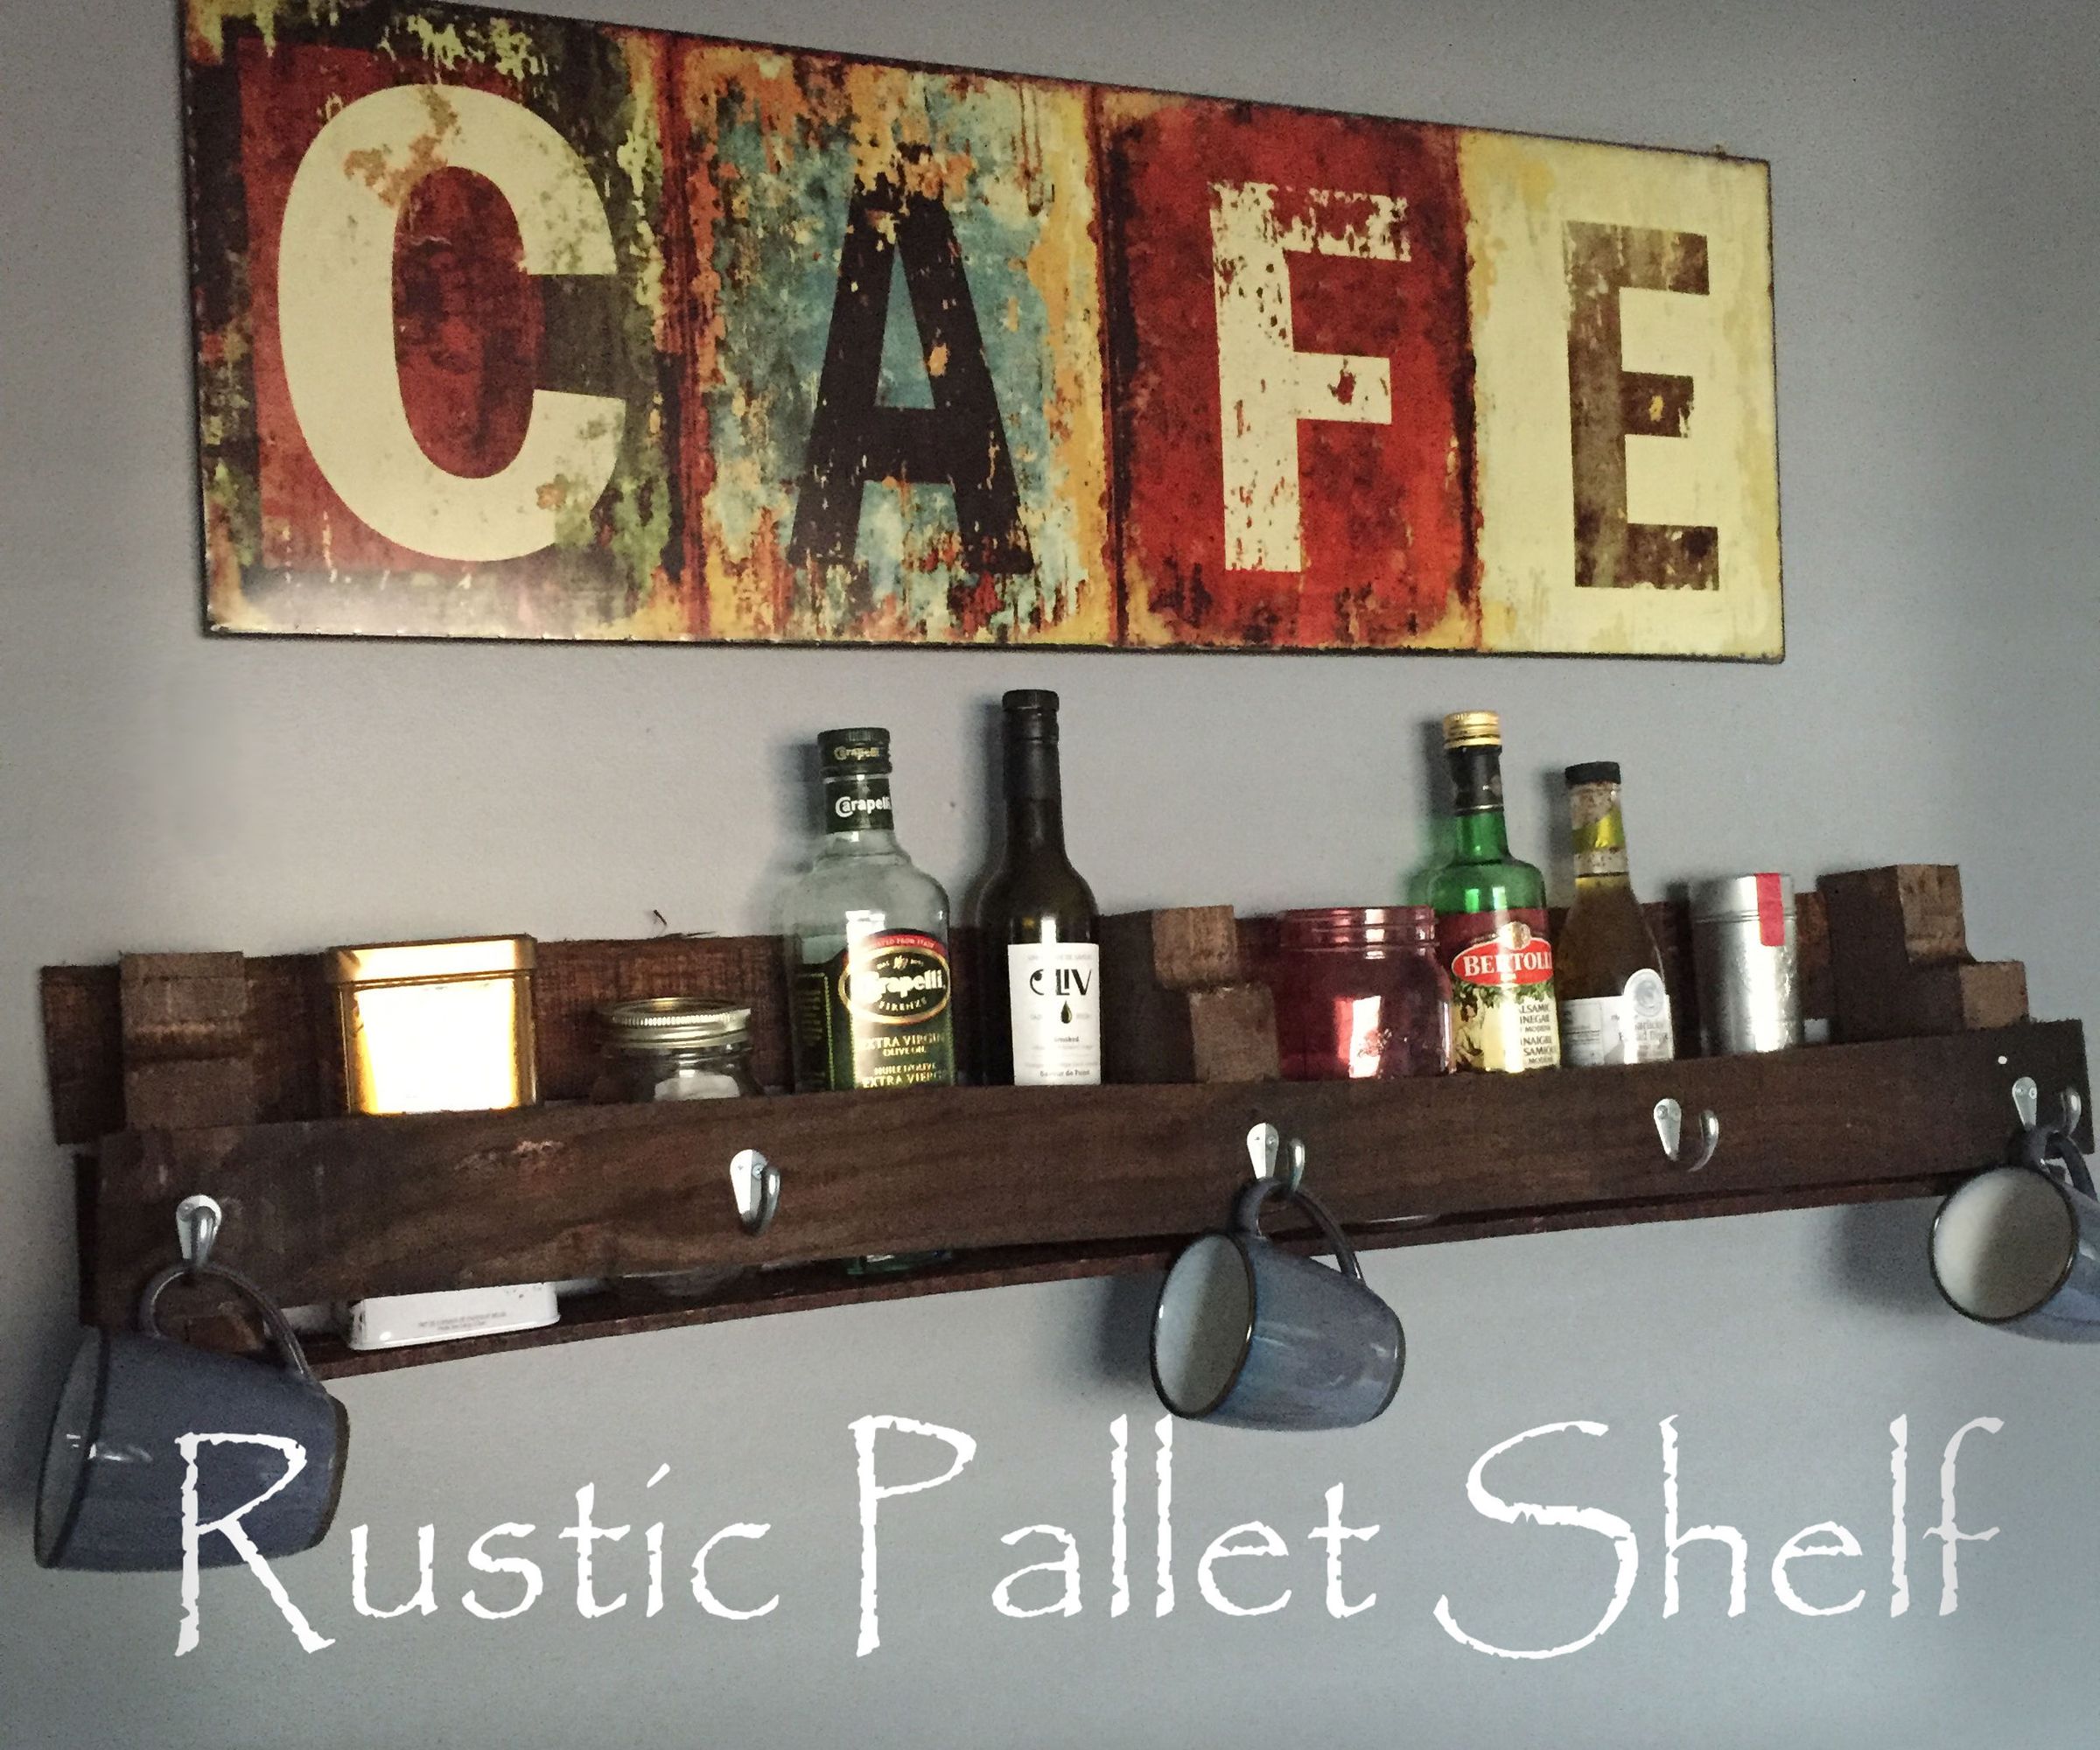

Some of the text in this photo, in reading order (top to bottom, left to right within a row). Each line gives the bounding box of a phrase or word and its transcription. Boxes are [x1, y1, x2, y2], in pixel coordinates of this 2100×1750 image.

[277, 83, 1718, 591] CAFE
[1029, 969, 1091, 996] OLIV
[882, 1047, 910, 1057] OLIVE
[861, 1074, 903, 1088] EXTRA
